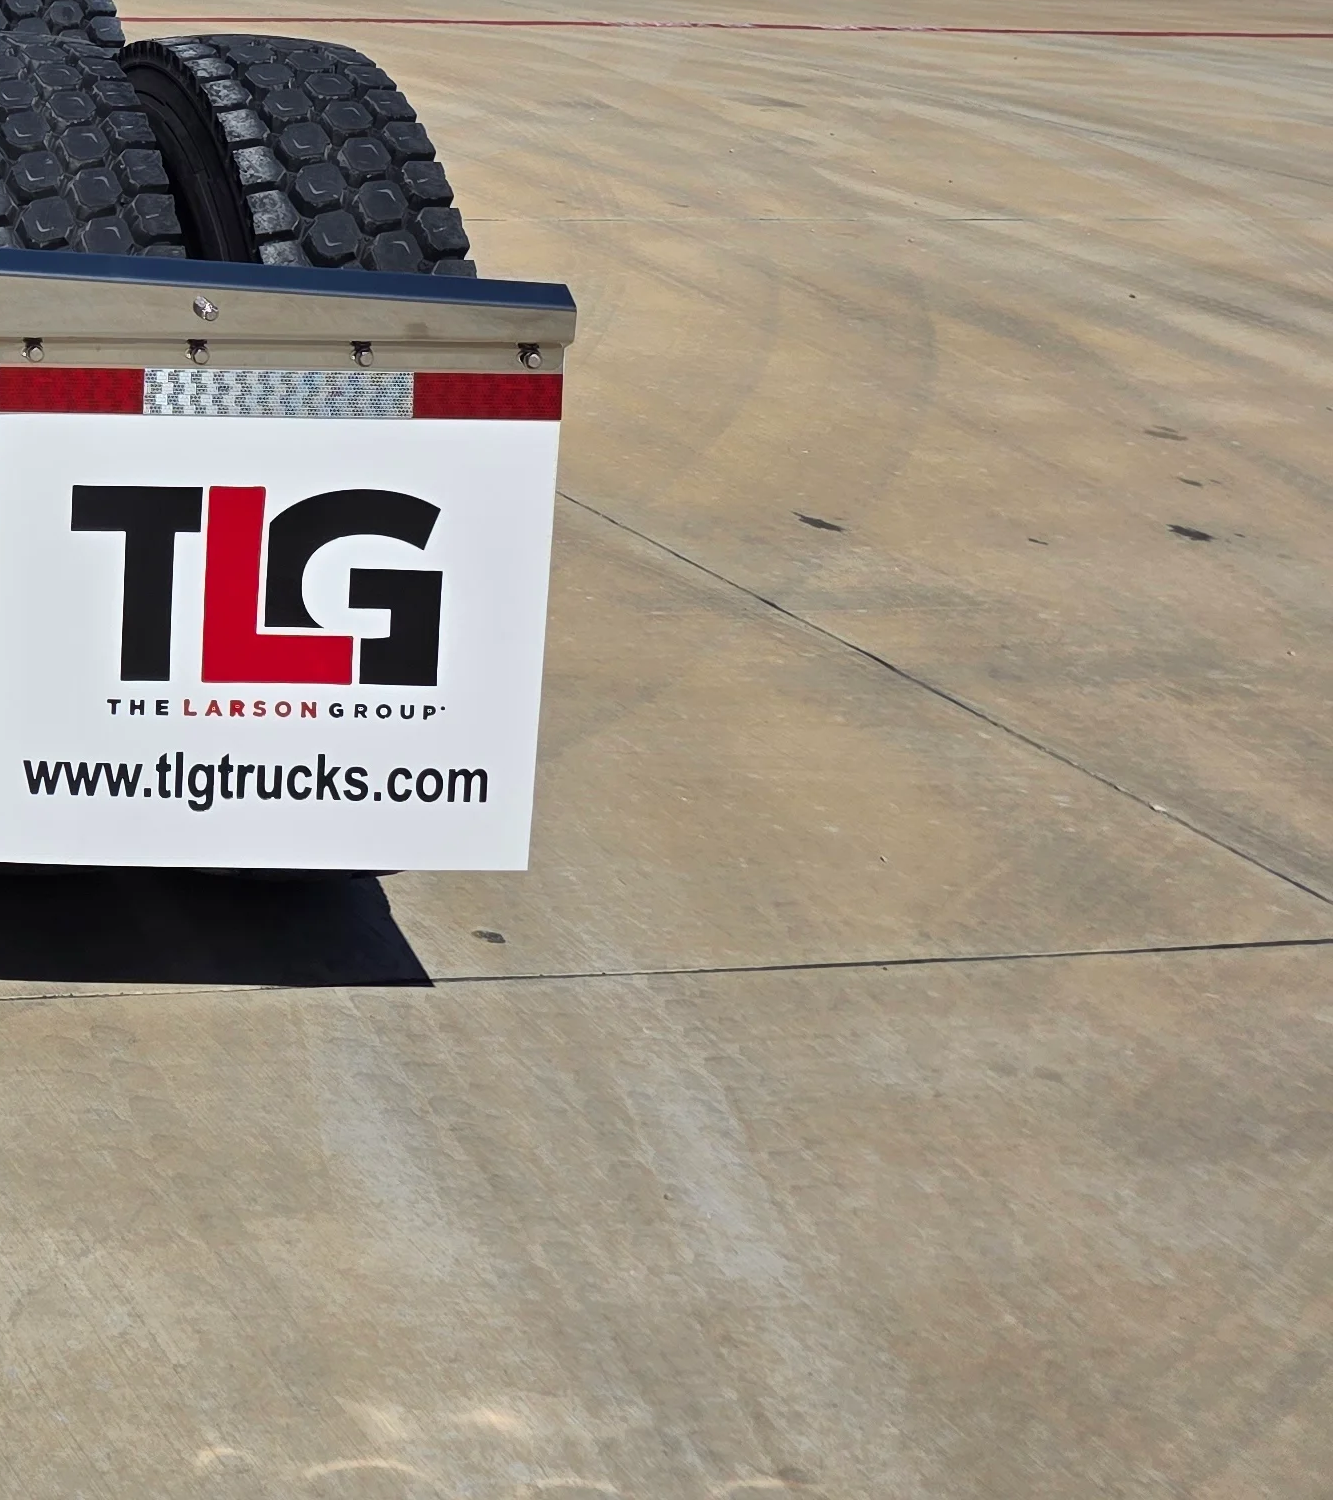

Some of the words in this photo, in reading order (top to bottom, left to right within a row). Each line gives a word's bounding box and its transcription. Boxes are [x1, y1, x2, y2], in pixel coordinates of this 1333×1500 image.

[70, 484, 444, 687] TLG
[106, 698, 170, 716] THE
[183, 698, 317, 719] LARSON
[328, 702, 437, 721] GROUP
[22, 751, 488, 812] www.tlgtrucks.com
